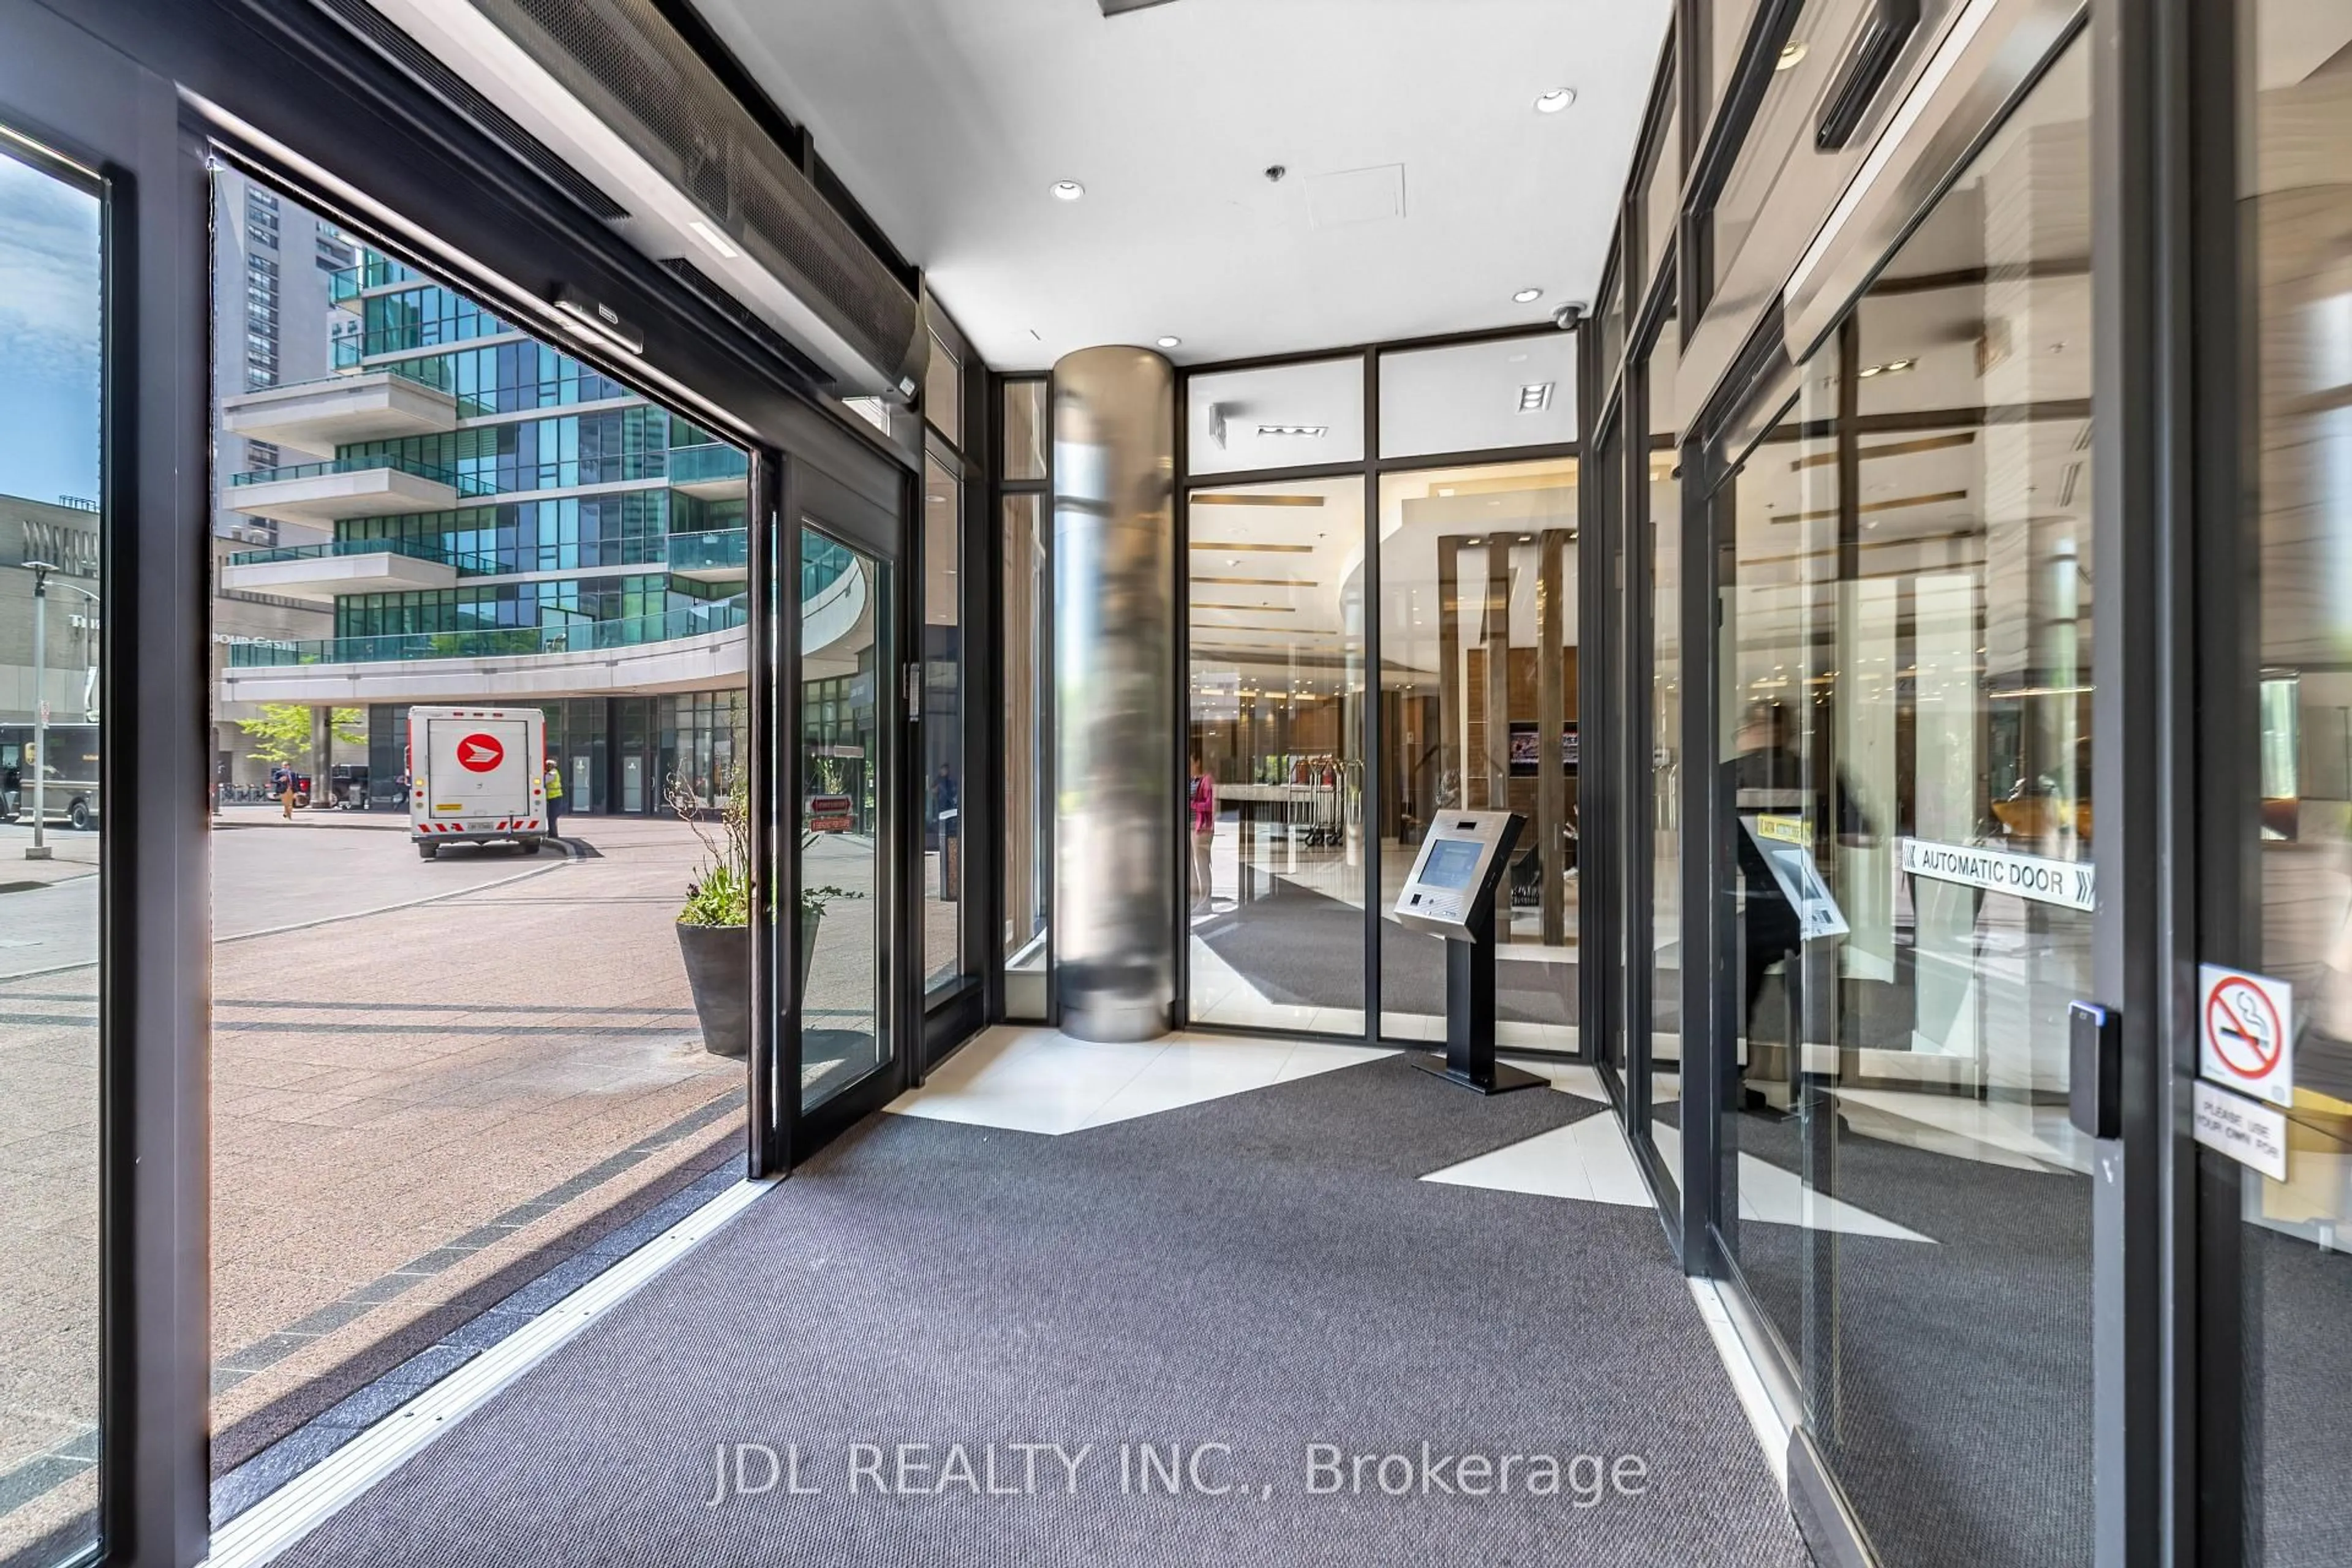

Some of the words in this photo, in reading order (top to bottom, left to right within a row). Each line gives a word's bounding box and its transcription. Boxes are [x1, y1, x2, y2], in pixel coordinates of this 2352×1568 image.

[1922, 850, 2005, 882] AUTOMATIC
[2010, 863, 2064, 894] DOOR
[2203, 1101, 2244, 1128] PLEASE
